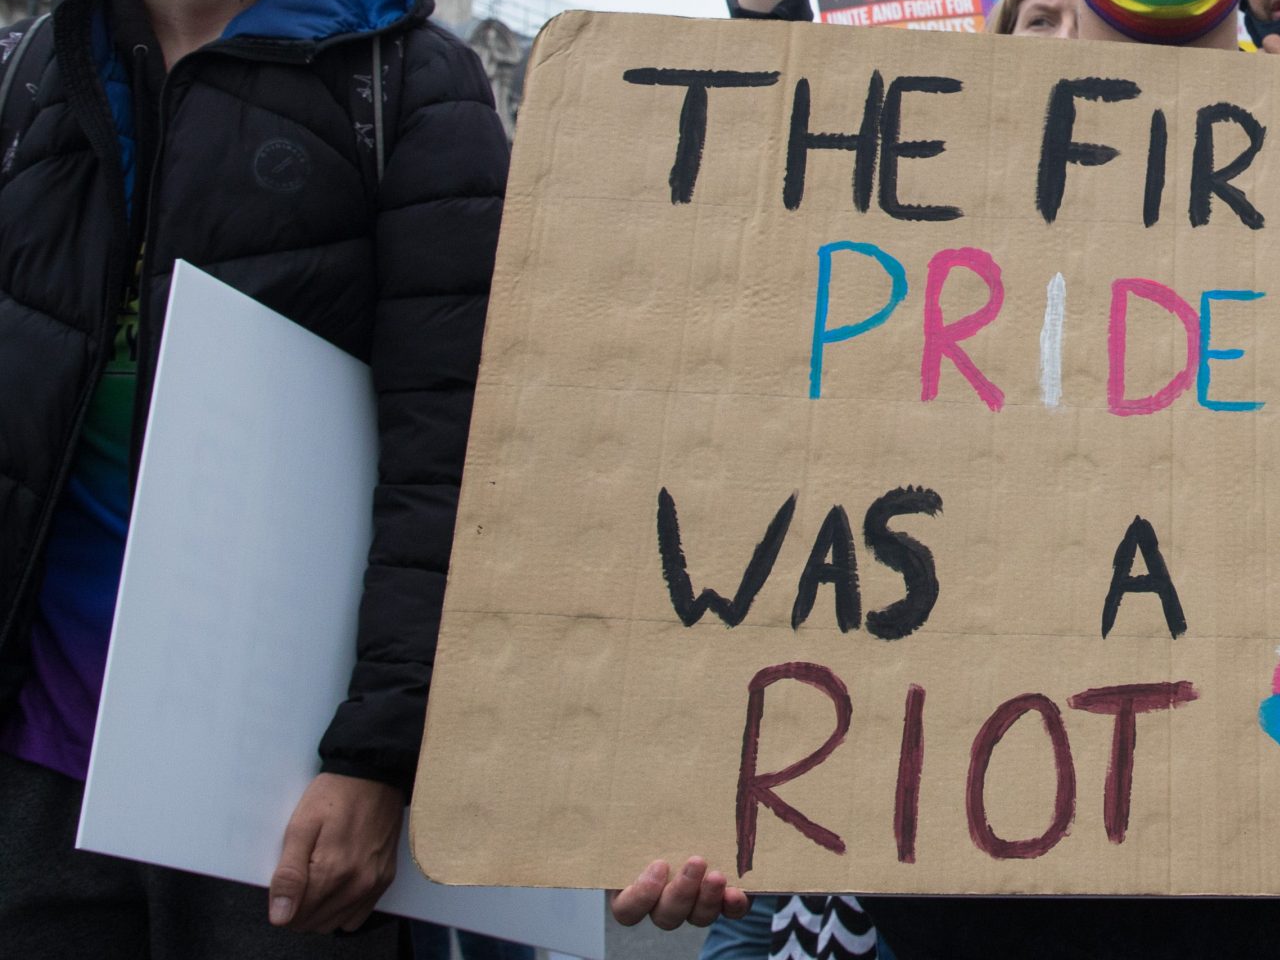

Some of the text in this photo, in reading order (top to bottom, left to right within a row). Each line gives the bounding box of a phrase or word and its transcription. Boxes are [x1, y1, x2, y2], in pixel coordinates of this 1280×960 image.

[826, 7, 868, 25] UNITE
[872, 2, 901, 23] AND
[622, 68, 965, 223] THE
[808, 240, 1267, 416] PRIDE
[656, 484, 1188, 642] WAS A
[735, 661, 1200, 879] RIOT
